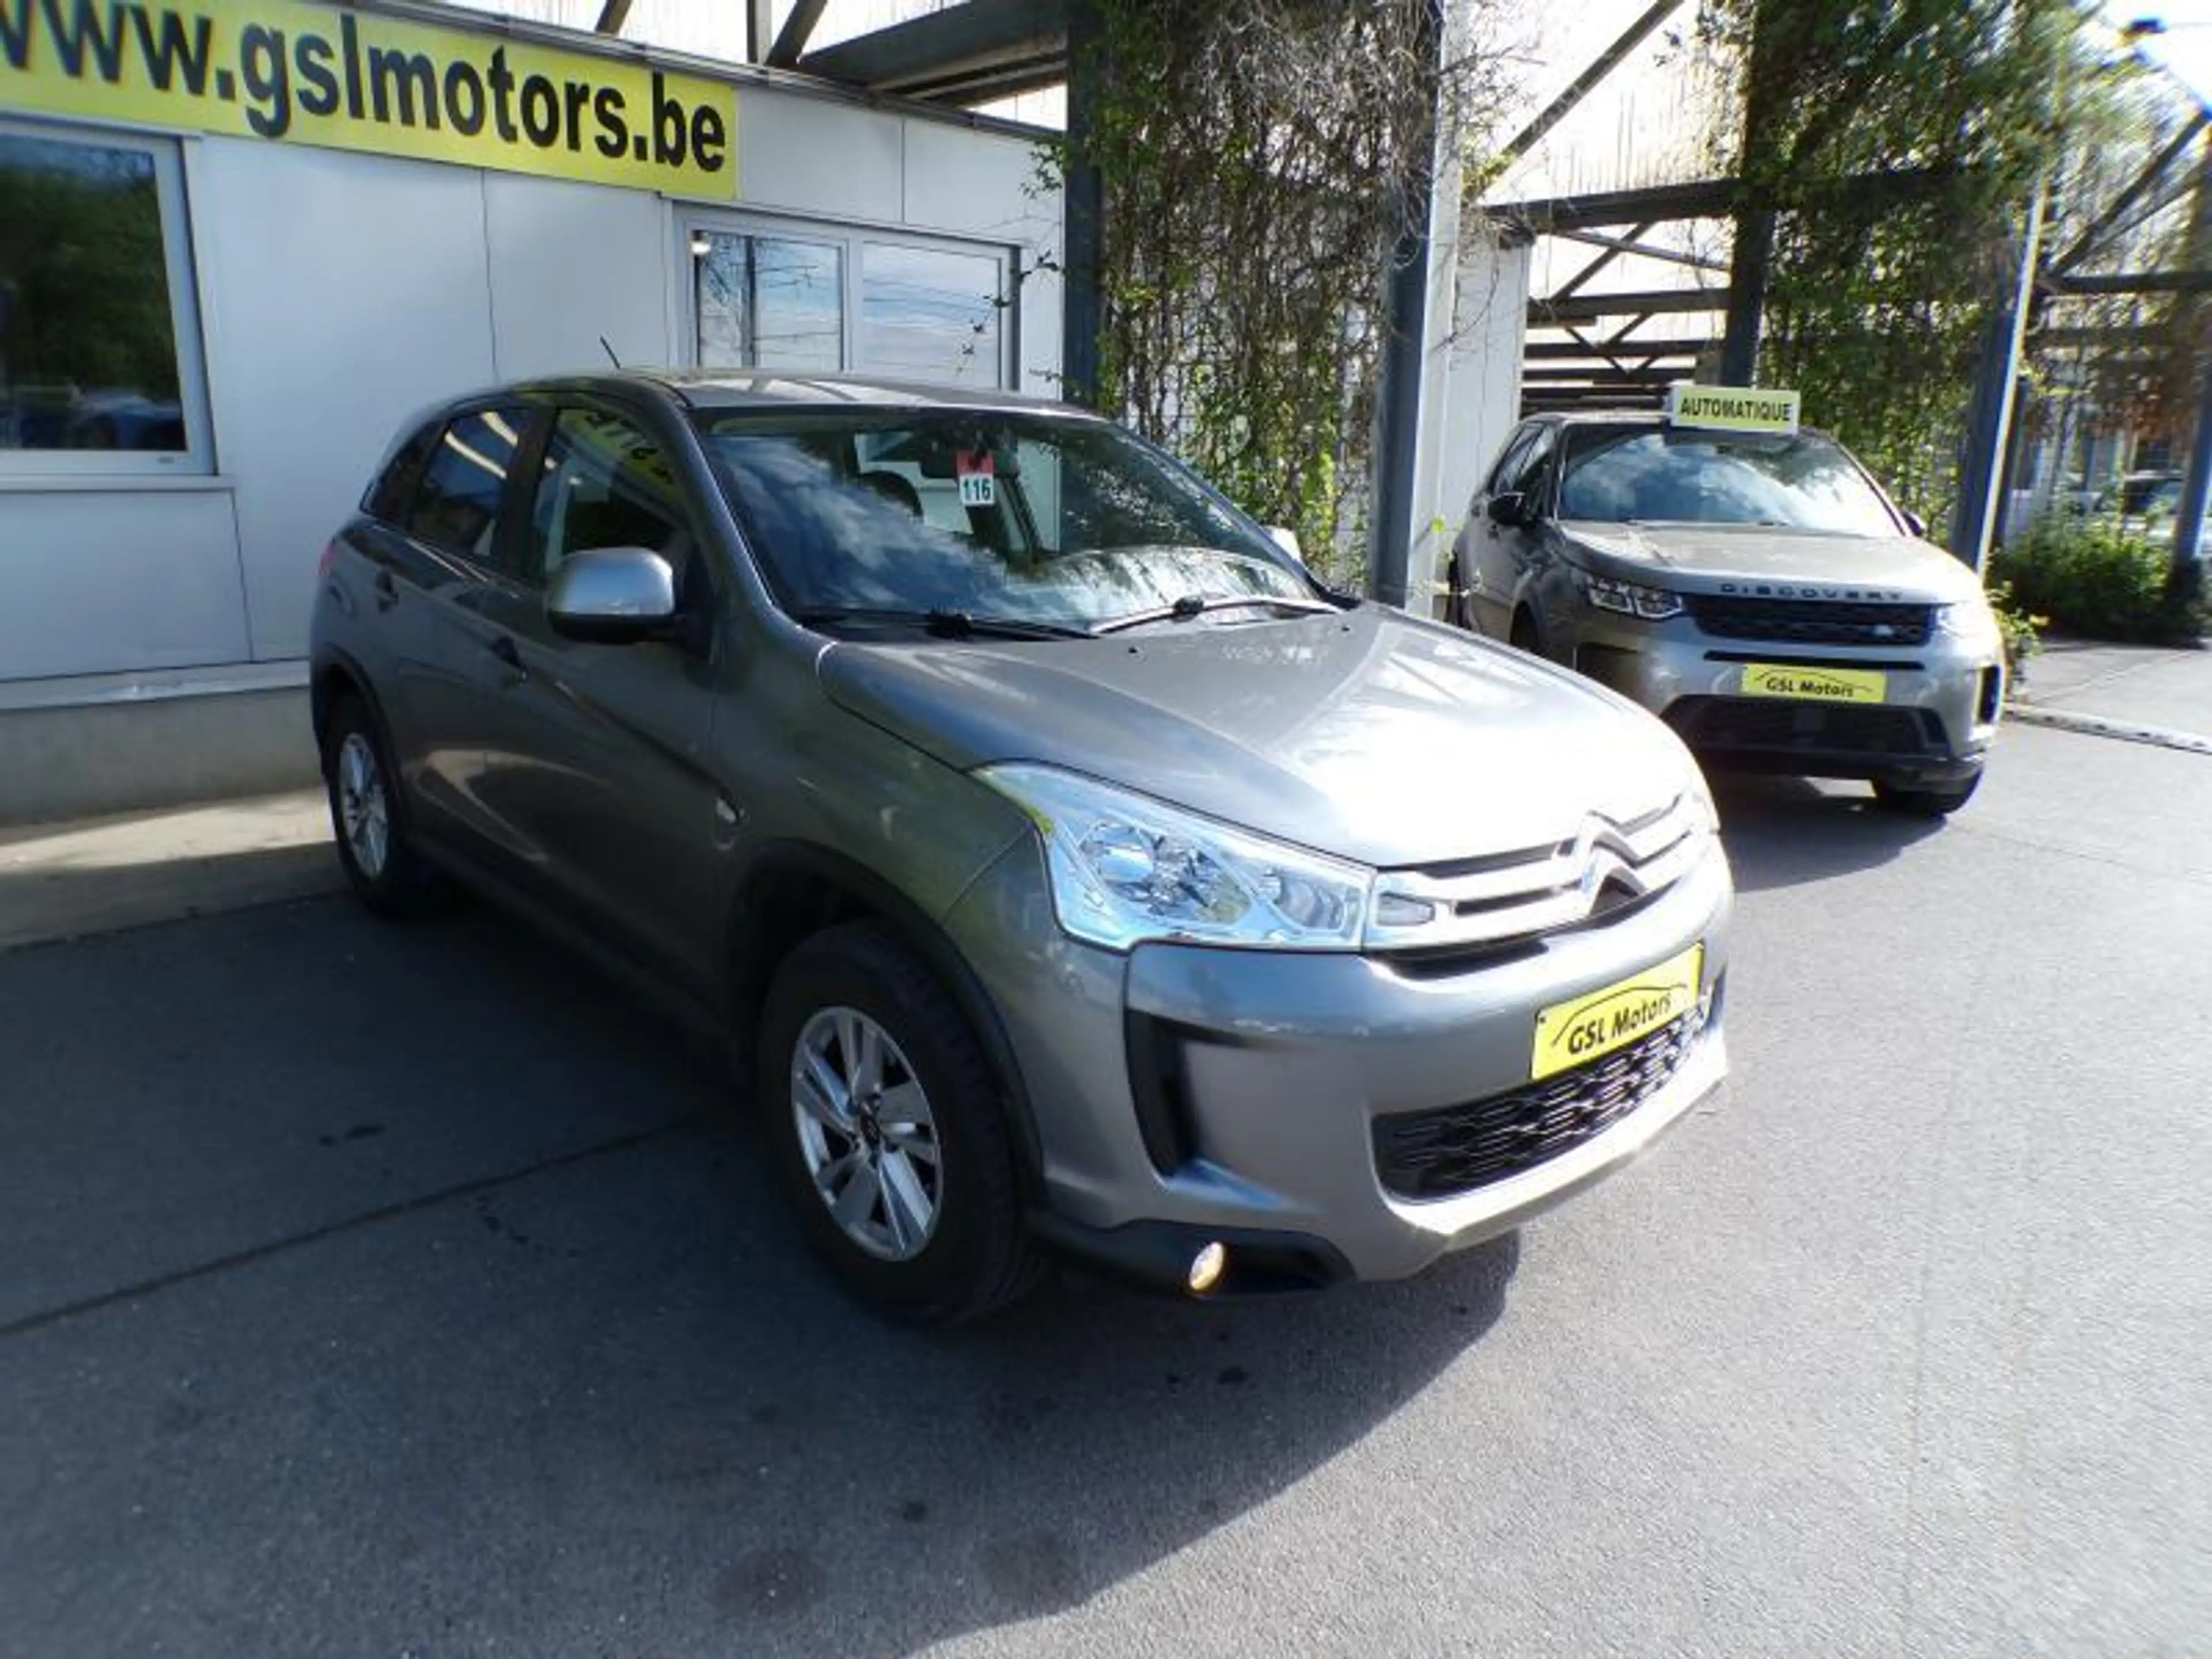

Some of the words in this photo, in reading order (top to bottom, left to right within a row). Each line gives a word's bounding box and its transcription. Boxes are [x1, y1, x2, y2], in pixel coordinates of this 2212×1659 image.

[1680, 396, 1793, 421] AUTOMATIQUE
[963, 478, 991, 501] 116
[1720, 583, 1902, 600] DISCOVERY
[1766, 679, 1796, 692] GSL
[1800, 681, 1854, 697] Motors
[1567, 1018, 1605, 1054] GSL
[1612, 993, 1672, 1037] Motors
